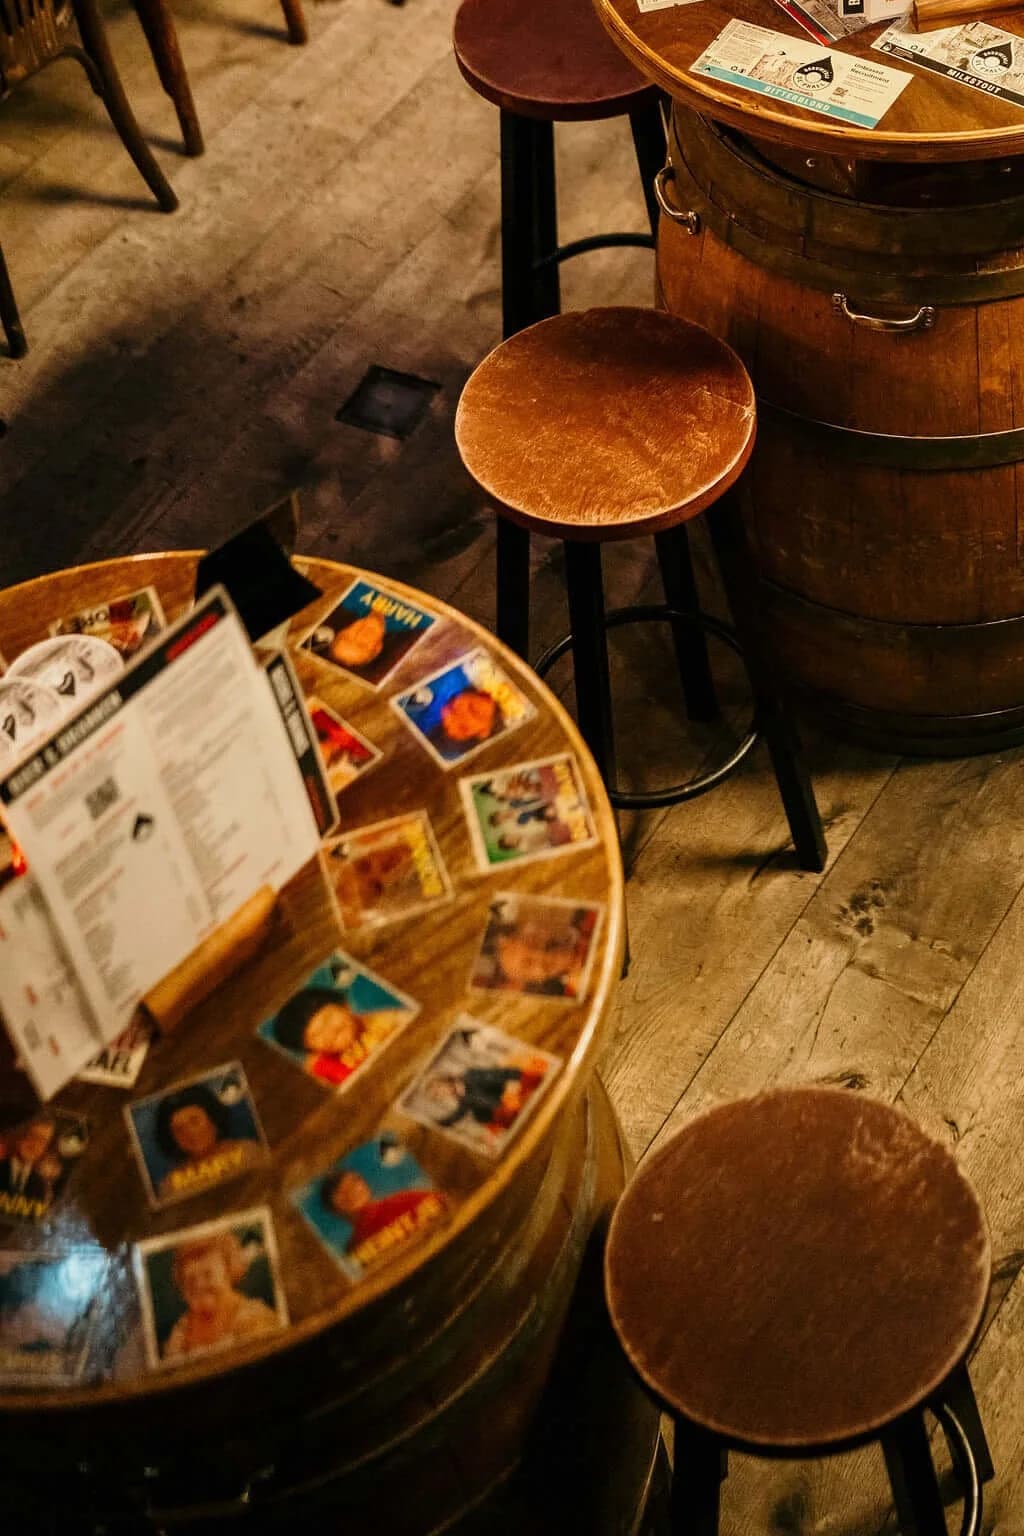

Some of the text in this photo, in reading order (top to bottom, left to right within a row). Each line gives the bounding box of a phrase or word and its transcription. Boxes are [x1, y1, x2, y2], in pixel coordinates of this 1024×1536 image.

[946, 68, 1002, 94] MILKSTOUT
[763, 85, 831, 112] BITTERBLOND
[360, 590, 423, 629] HARRY
